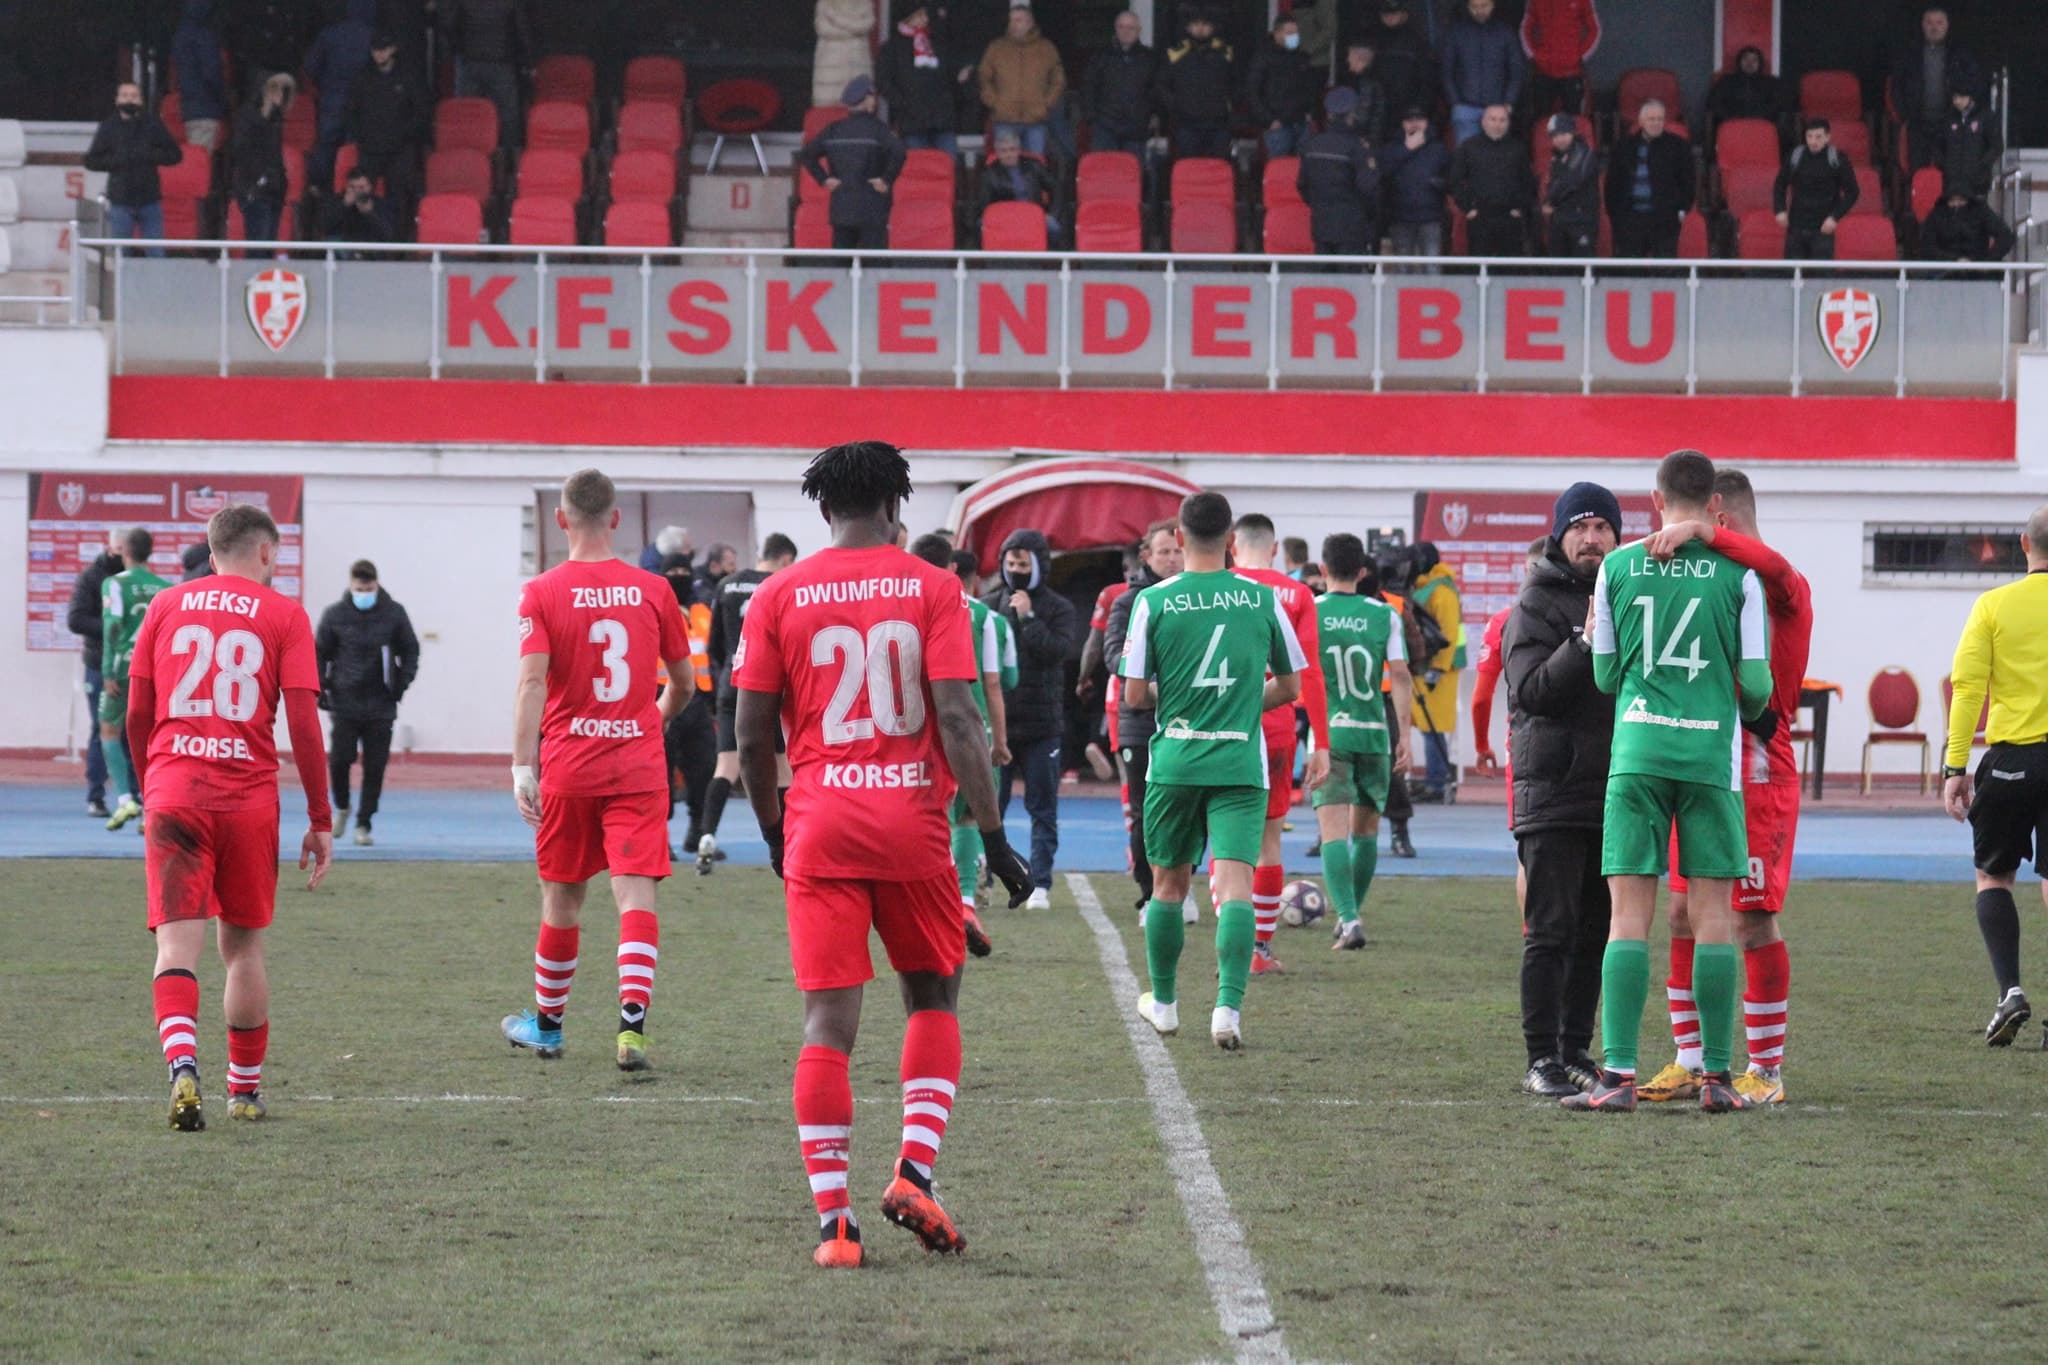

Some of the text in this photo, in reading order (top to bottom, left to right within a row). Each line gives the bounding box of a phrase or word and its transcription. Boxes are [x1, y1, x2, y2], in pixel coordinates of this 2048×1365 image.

[666, 279, 1676, 365] SKENDERBEU
[1630, 556, 1717, 579] LEVENDI
[181, 590, 261, 619] MEKSI
[571, 586, 643, 609] ZGURO
[795, 577, 922, 608] DWUMFOUR
[1163, 589, 1262, 615] ASLLANAJ
[588, 618, 631, 703] 3
[1191, 623, 1238, 699] 4
[1632, 595, 1711, 684] 14
[168, 624, 265, 723] 28
[811, 619, 926, 745] 20
[1325, 644, 1375, 701] 10
[569, 717, 645, 738] KORSEL
[823, 761, 932, 789] KORSEL
